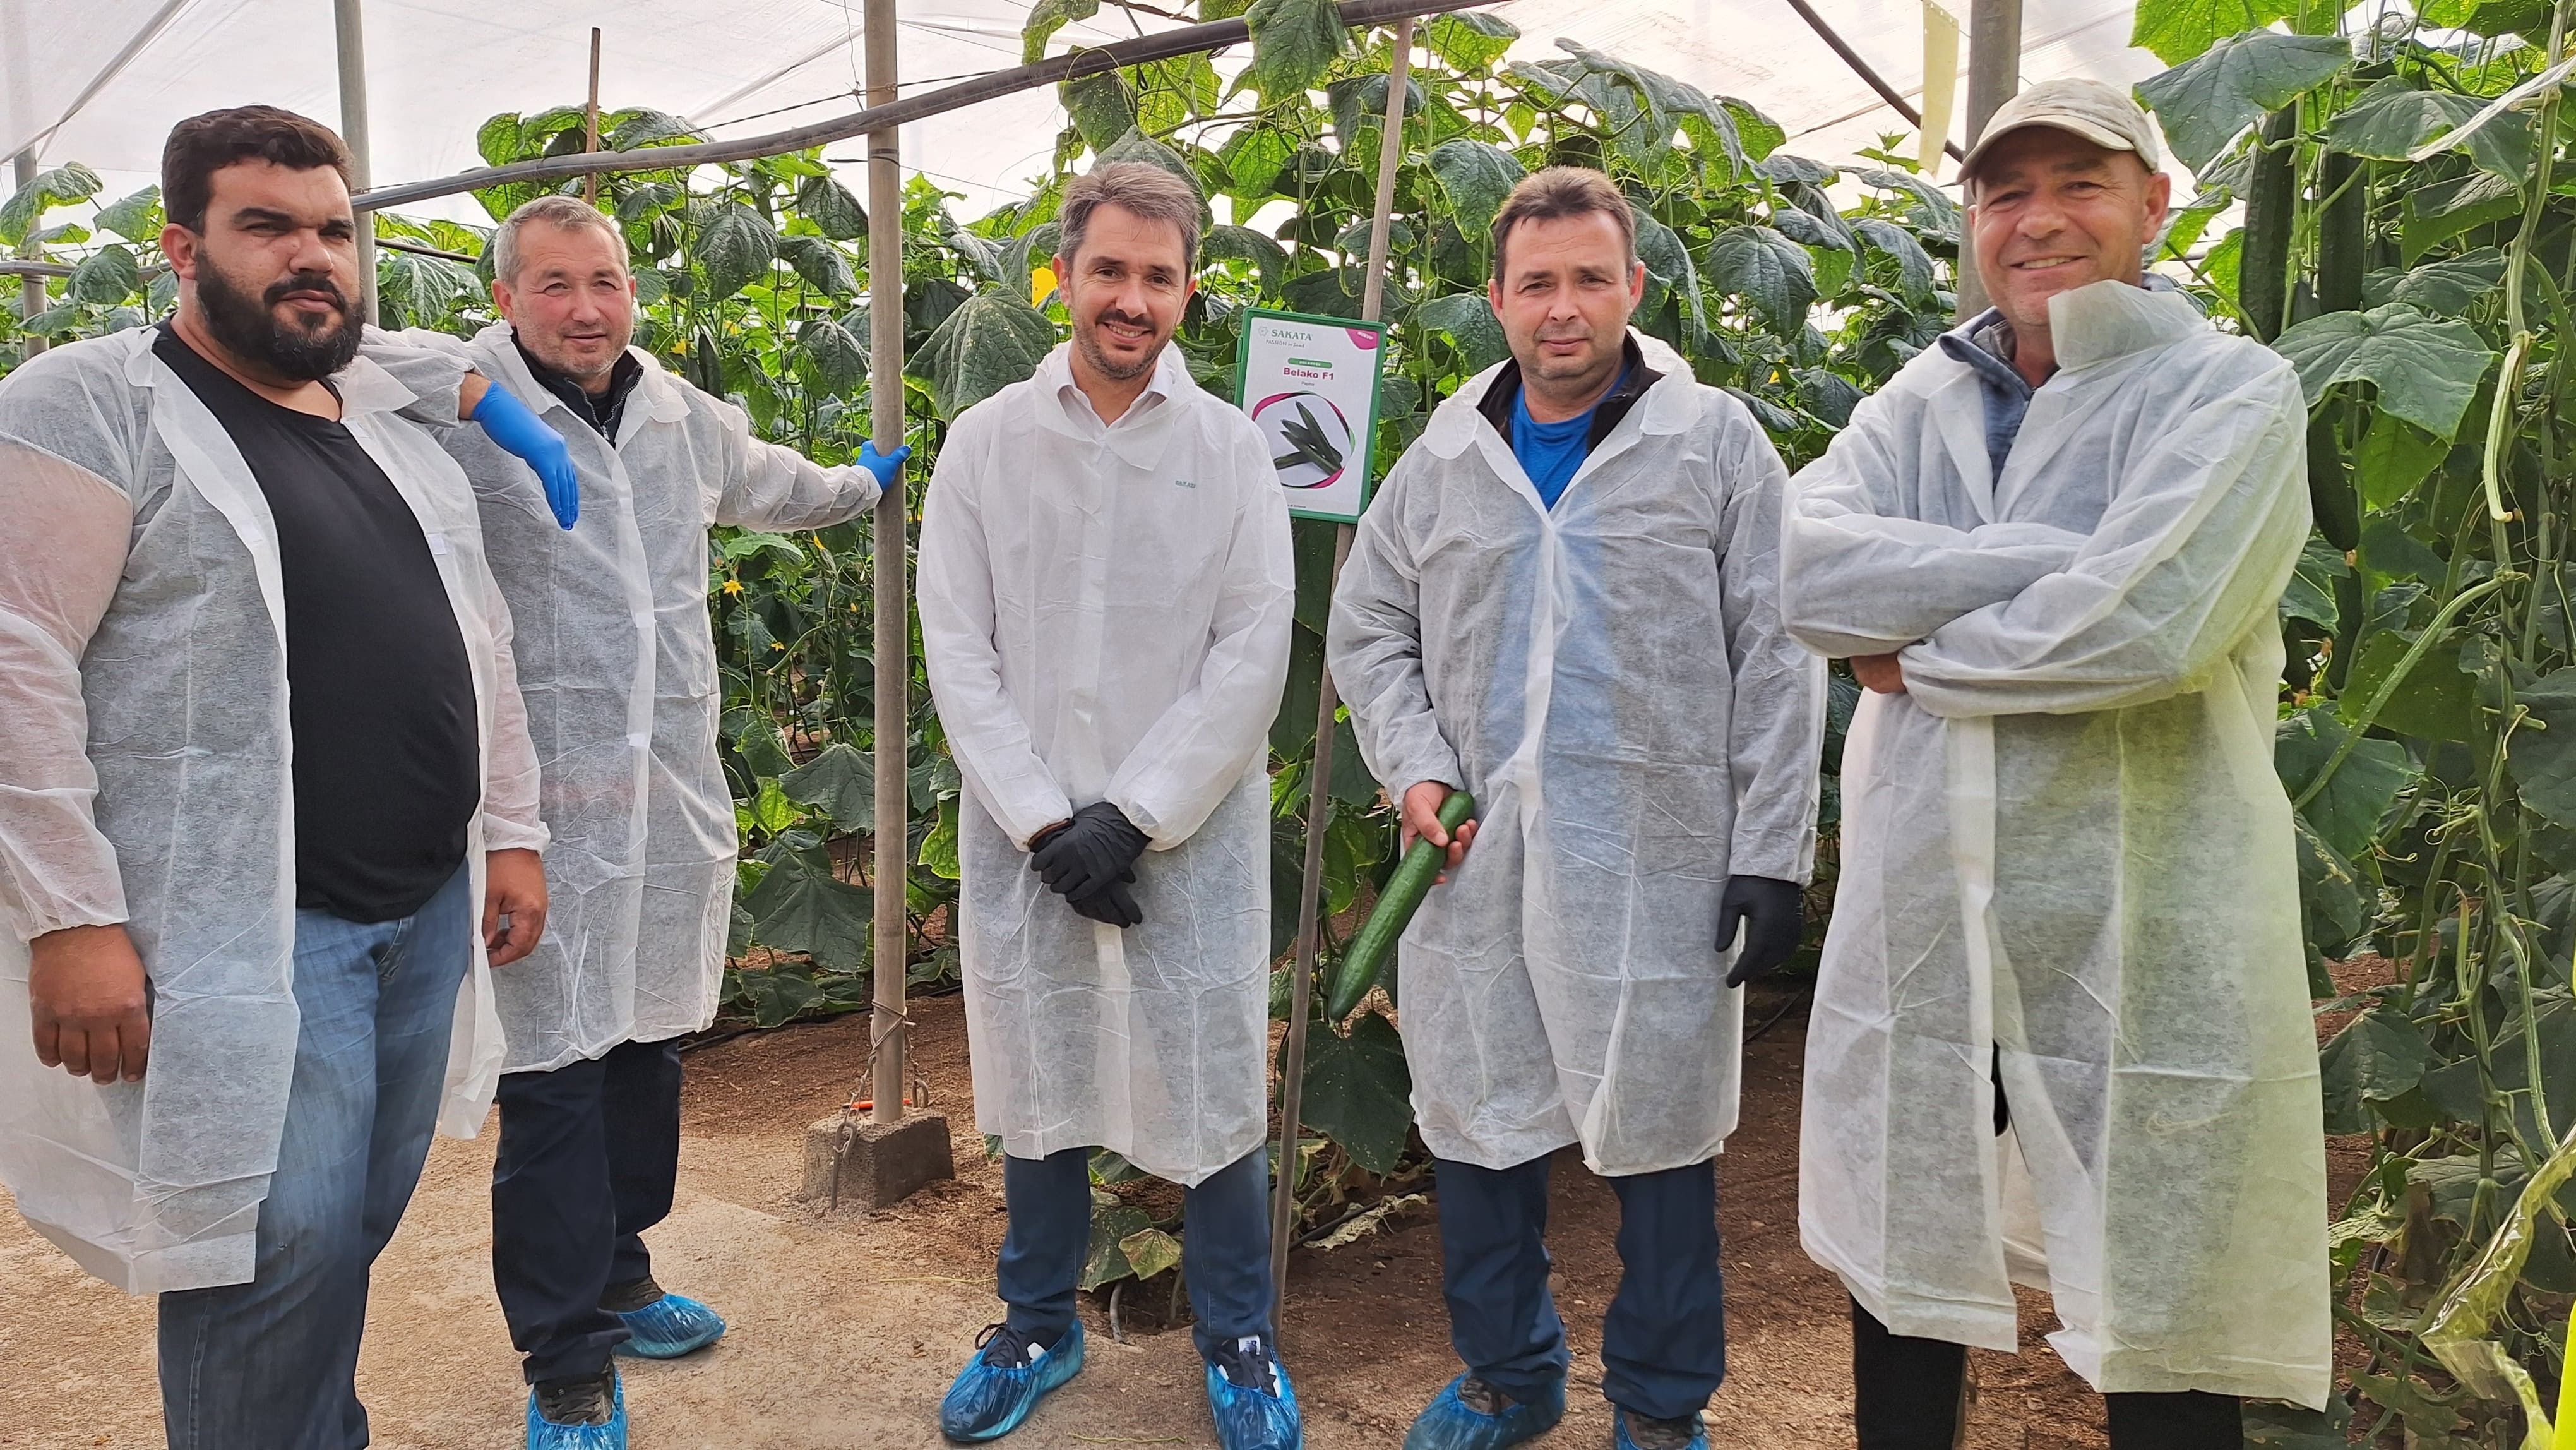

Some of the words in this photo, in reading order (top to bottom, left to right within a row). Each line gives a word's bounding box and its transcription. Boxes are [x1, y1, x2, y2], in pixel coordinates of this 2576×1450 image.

[1271, 329, 1311, 341] SAKATA
[1283, 368, 1318, 378] Belako
[1322, 372, 1333, 380] F1
